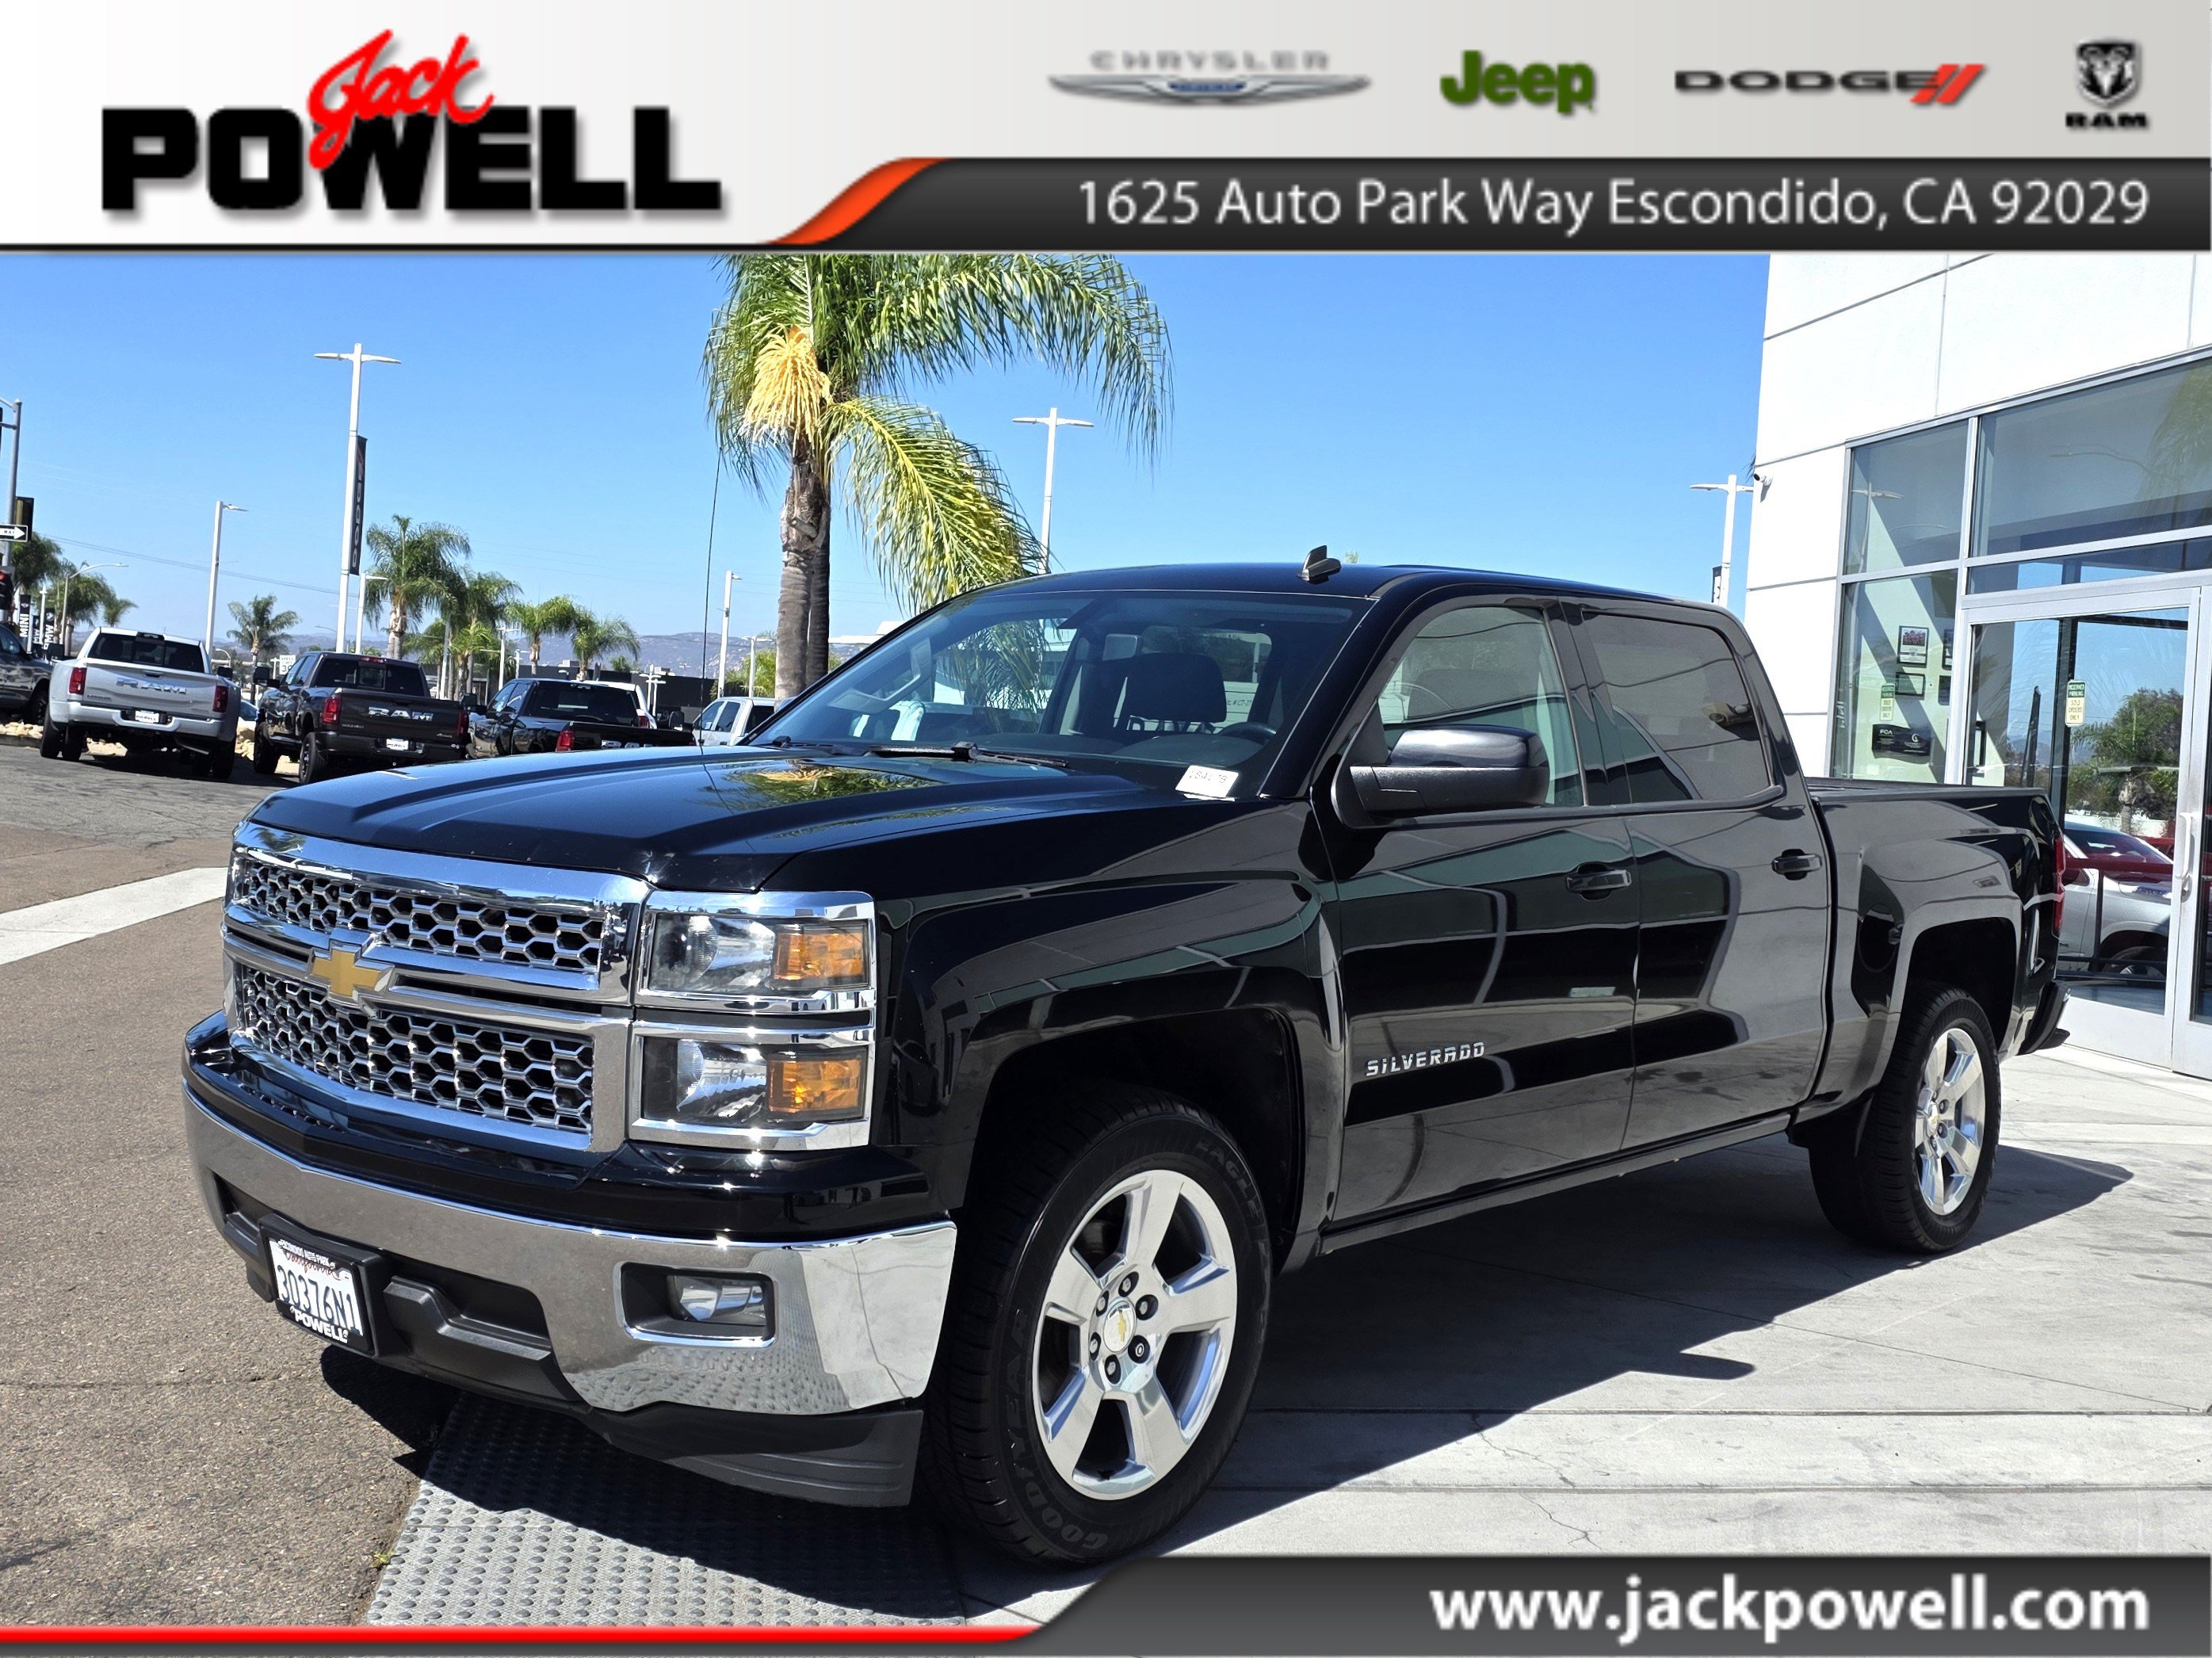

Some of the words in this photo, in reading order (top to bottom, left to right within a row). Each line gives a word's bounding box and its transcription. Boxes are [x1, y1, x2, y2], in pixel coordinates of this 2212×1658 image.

[19, 613, 29, 638] MINI
[116, 678, 187, 695] RAM
[369, 706, 434, 722] RAM
[1366, 1041, 1485, 1077] SILVERADO
[277, 1265, 359, 1333] 30376N1
[295, 1308, 348, 1343] POWELL
[1006, 1308, 1109, 1550] GOODYEAR
